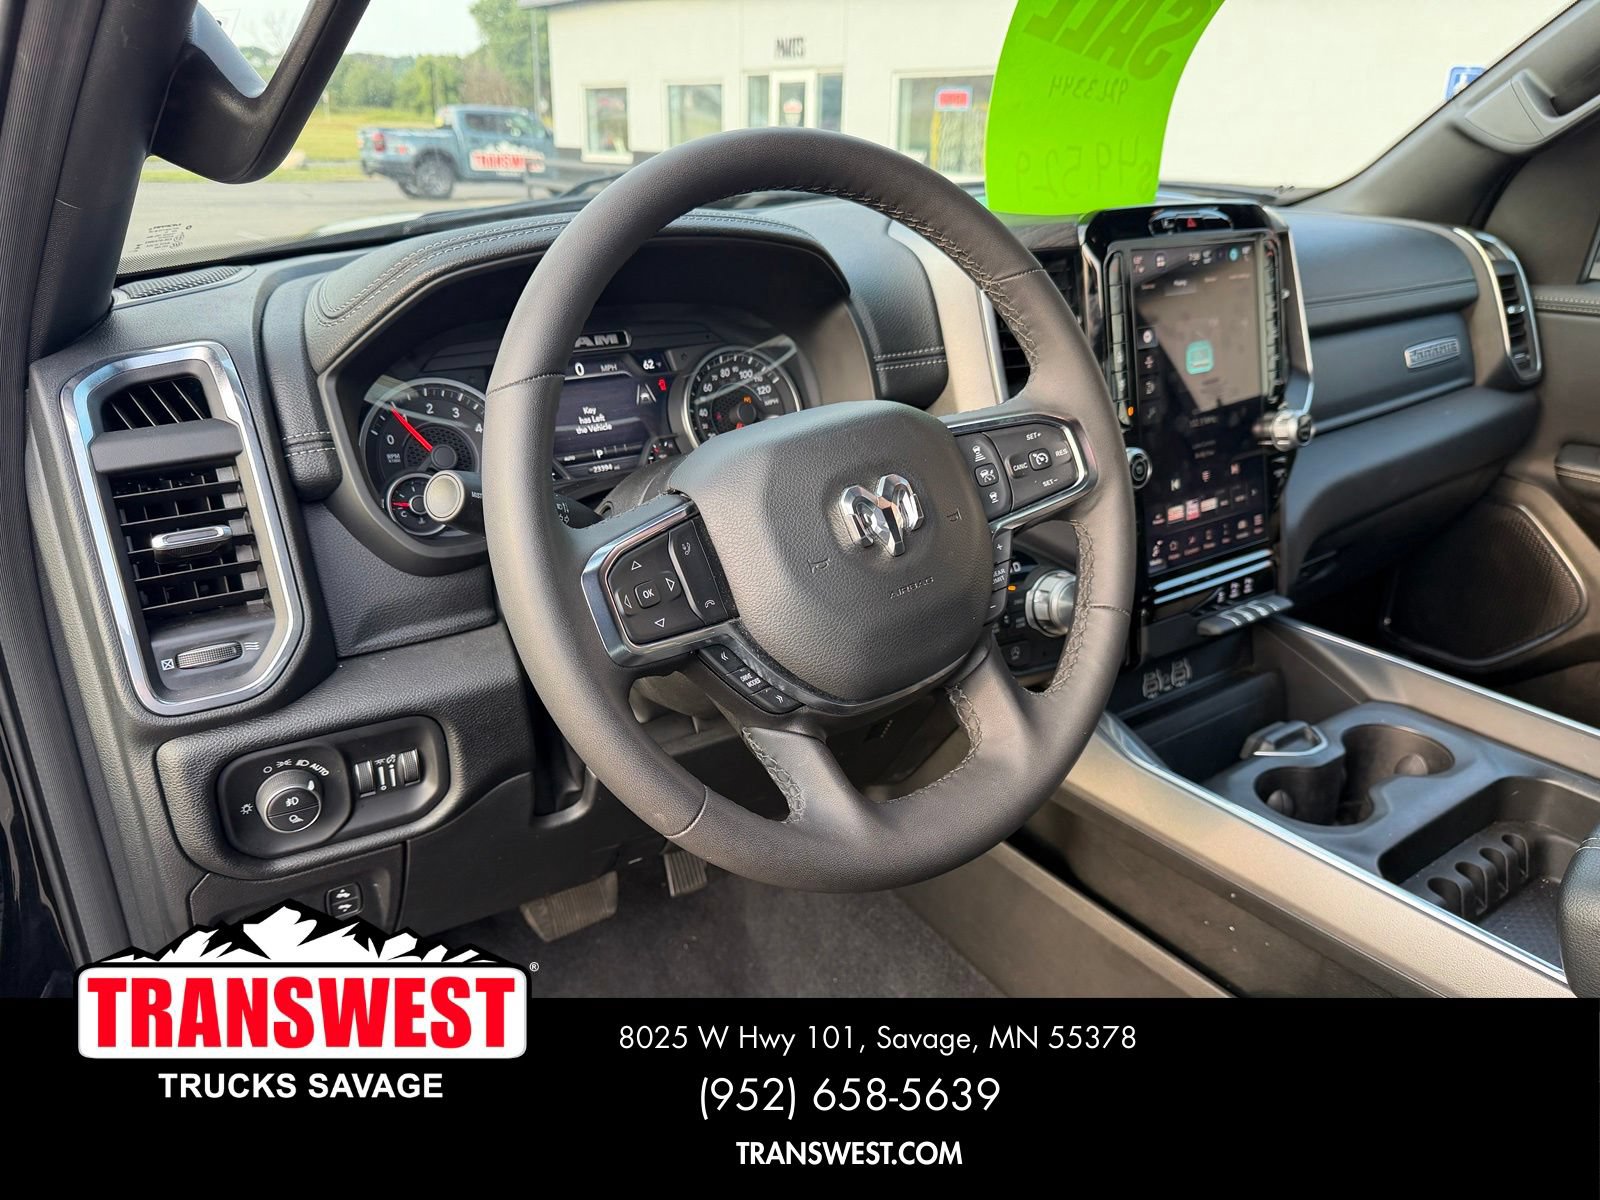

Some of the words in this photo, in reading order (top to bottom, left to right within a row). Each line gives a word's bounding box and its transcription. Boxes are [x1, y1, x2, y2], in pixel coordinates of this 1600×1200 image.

[574, 333, 619, 348] AM
[574, 362, 585, 376] 0
[600, 363, 618, 373] MPH
[642, 358, 655, 370] 62
[720, 367, 730, 378] 80
[739, 369, 753, 379] 100
[703, 383, 712, 392] 60
[756, 385, 772, 395] 120
[426, 403, 435, 414] 2
[452, 407, 460, 418] 3
[582, 406, 597, 416] Key
[699, 408, 709, 418] 40
[578, 416, 591, 425] has
[591, 413, 606, 423] Left
[475, 422, 483, 434] 4
[575, 424, 588, 435] the
[588, 422, 613, 433] Vehicle
[386, 434, 395, 446] 0
[1026, 432, 1042, 441] SET+
[596, 449, 604, 459] P
[1055, 448, 1068, 457] RES
[1012, 462, 1028, 472] CANC
[642, 589, 655, 599] OK
[740, 672, 753, 682] DRIVE
[309, 762, 330, 777] AUTO
